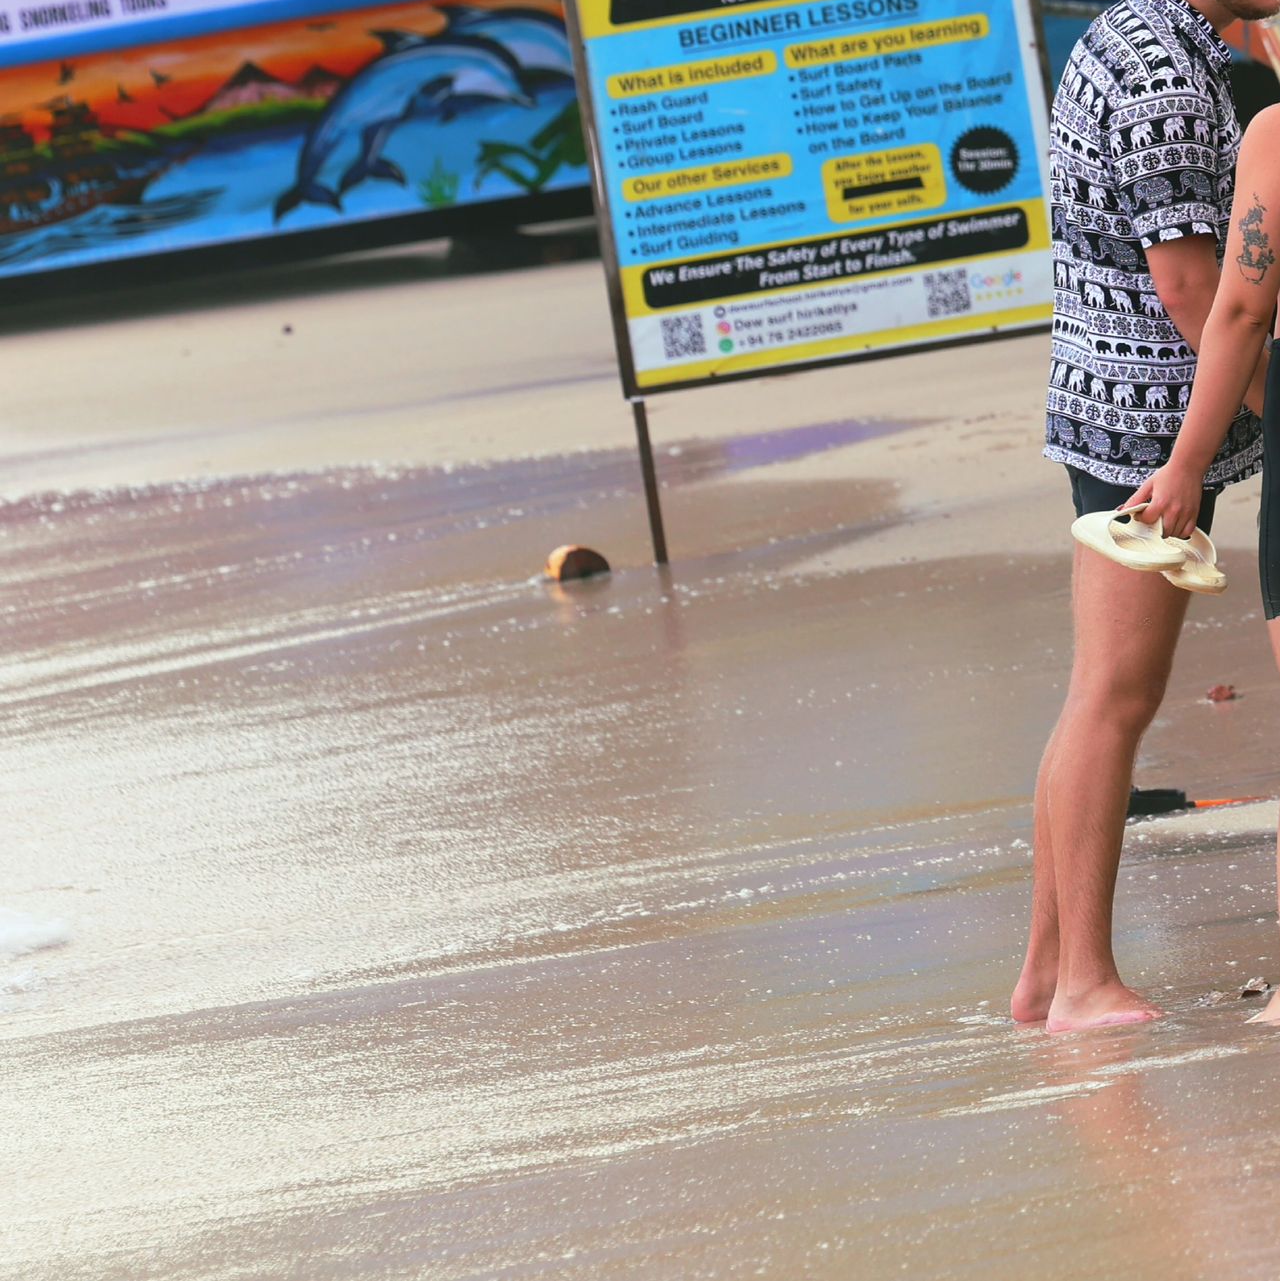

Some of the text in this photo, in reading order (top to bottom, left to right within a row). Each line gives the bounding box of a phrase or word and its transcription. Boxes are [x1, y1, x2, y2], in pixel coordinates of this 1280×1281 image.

[679, 11, 801, 48] BEGINNER
[790, 20, 981, 62] What are you learning
[617, 56, 764, 92] What is included
[632, 159, 780, 194] Our other Services
[649, 213, 1020, 287] We Ensure The Safety of Every Type of Swimmer
[759, 248, 916, 287] From Start to Finish.
[970, 268, 1022, 288] Google
